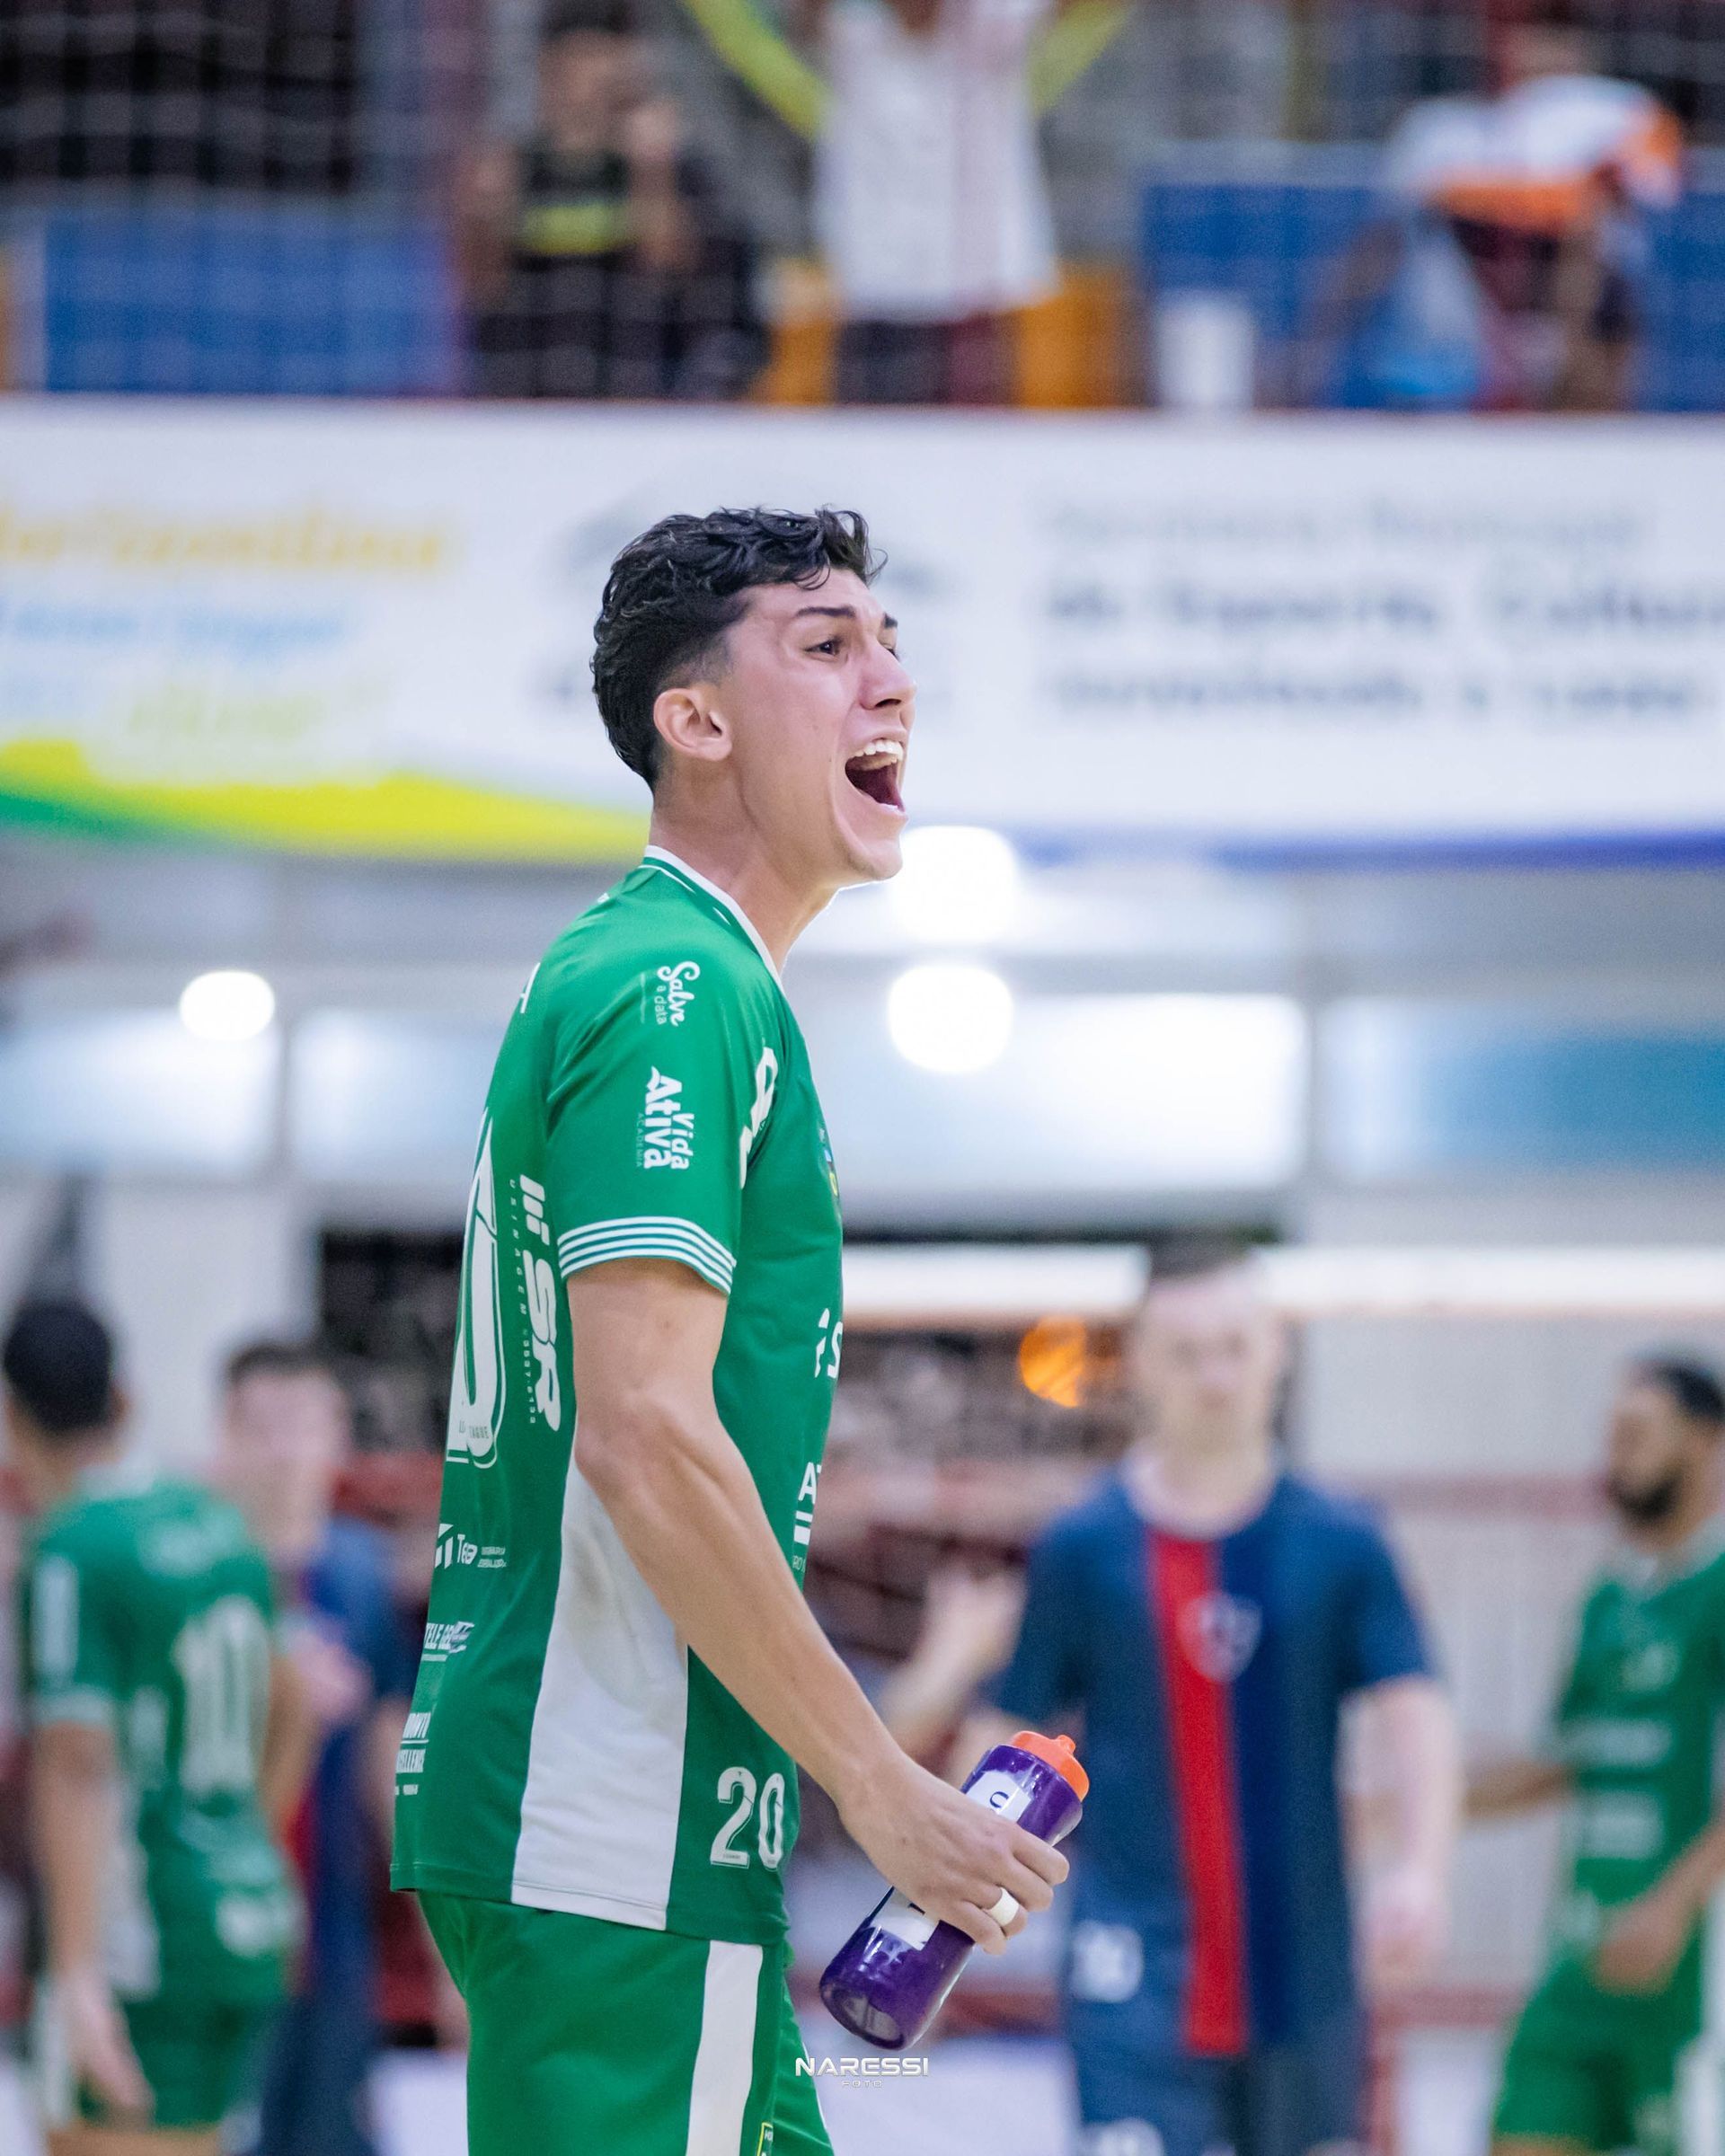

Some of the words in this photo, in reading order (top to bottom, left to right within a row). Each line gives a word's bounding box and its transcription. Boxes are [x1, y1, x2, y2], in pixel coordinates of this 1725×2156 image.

[653, 995, 668, 1025] data
[657, 960, 701, 1027] Salve
[644, 1065, 683, 1169] Ativa
[670, 1112, 695, 1170] Vida
[509, 1179, 527, 1315] USINAGEM
[710, 1766, 785, 1872] 20
